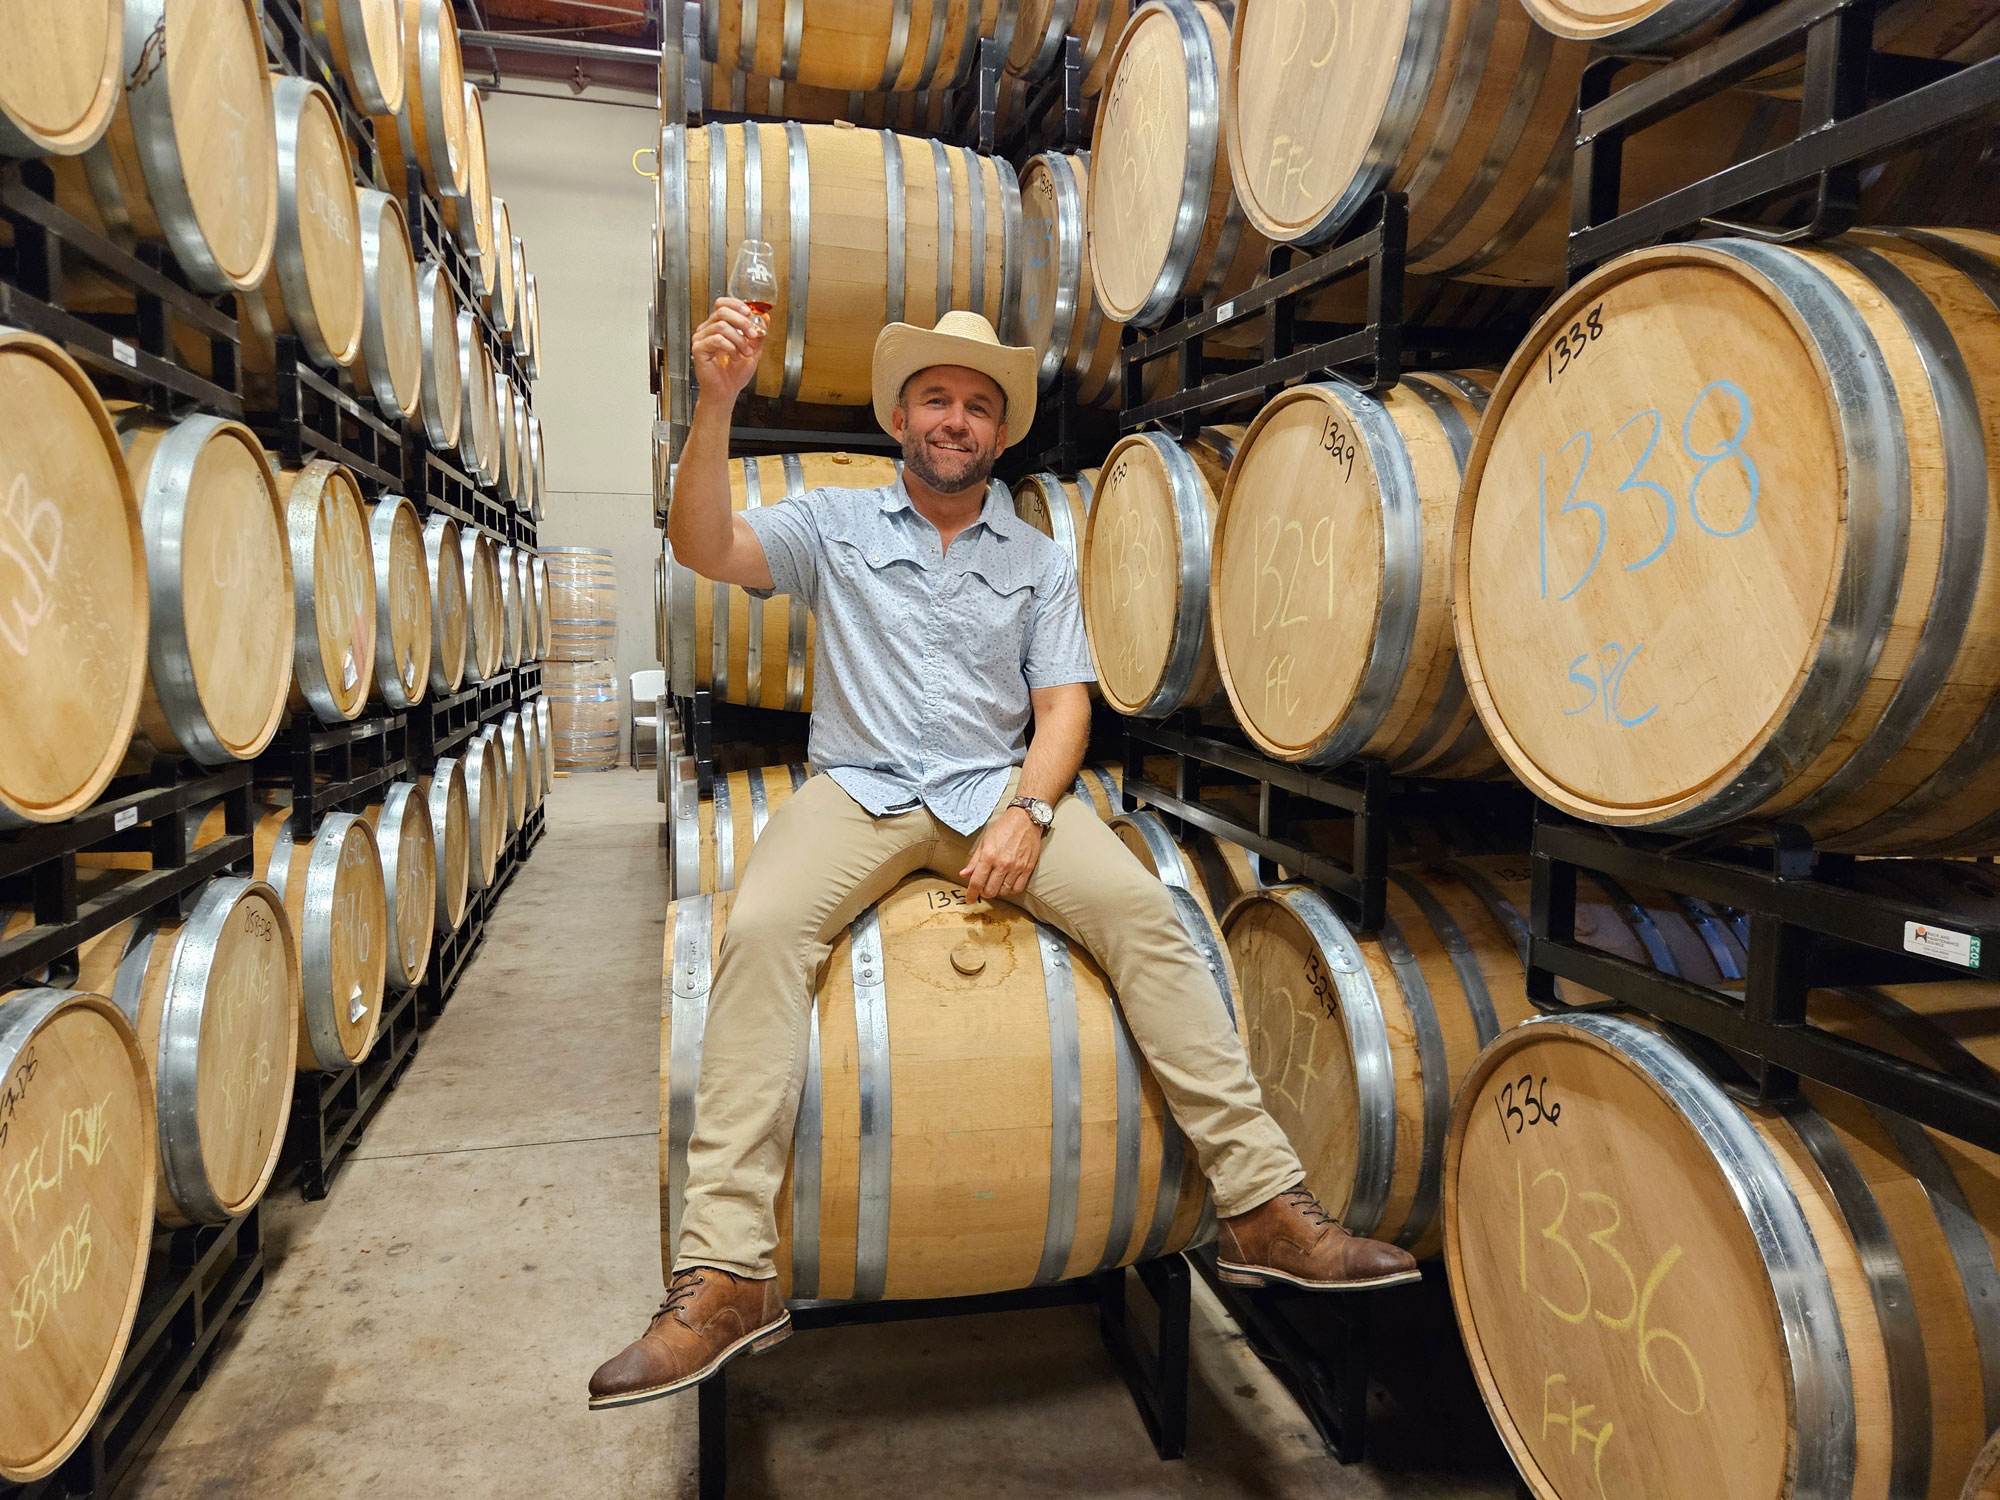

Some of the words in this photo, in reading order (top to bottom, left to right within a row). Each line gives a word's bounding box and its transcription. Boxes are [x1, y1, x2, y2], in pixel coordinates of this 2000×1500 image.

[1548, 302, 1605, 384] 1338
[1109, 461, 1128, 497] 1330
[1319, 415, 1355, 484] 1329
[1539, 379, 1761, 602] 1338
[1108, 509, 1164, 612] 1330
[1251, 515, 1335, 637] 1329
[1562, 641, 1659, 728] SPC
[1303, 948, 1338, 1019] 1327
[1970, 939, 1981, 968] 2023
[1495, 1075, 1561, 1144] 1336
[1516, 1160, 1706, 1415] 1336
